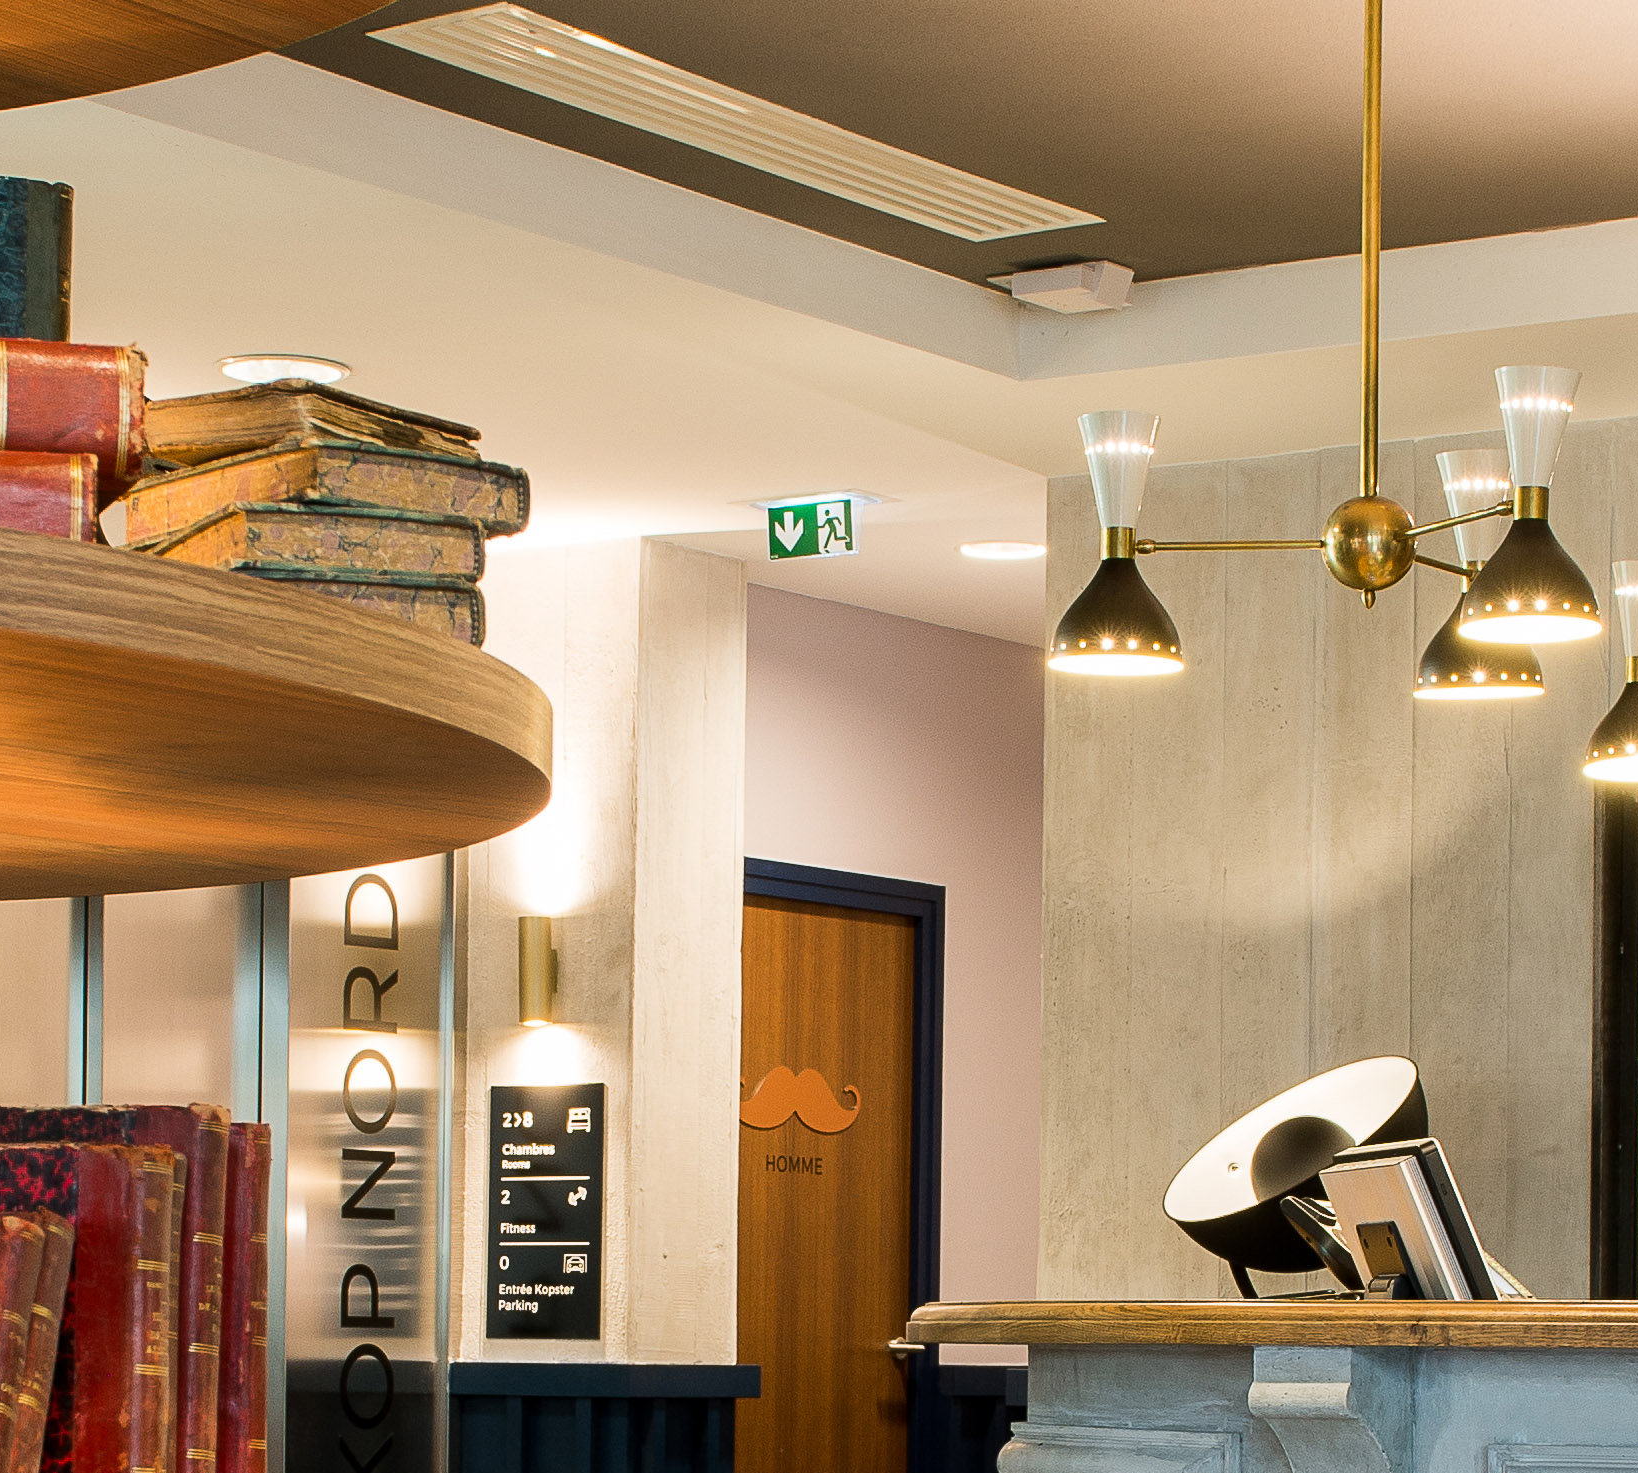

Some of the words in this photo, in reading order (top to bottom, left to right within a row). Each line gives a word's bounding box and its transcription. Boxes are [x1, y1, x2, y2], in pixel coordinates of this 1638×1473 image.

[341, 873, 400, 1221] NORD
[501, 1143, 556, 1156] Chambres
[501, 1160, 531, 1170] Rooms
[765, 1154, 823, 1175] HOMME
[500, 1190, 511, 1205] 2
[500, 1223, 536, 1234] Fitness
[498, 1283, 533, 1295] Entrée
[534, 1284, 575, 1298] Kopster
[498, 1299, 539, 1313] Parking
